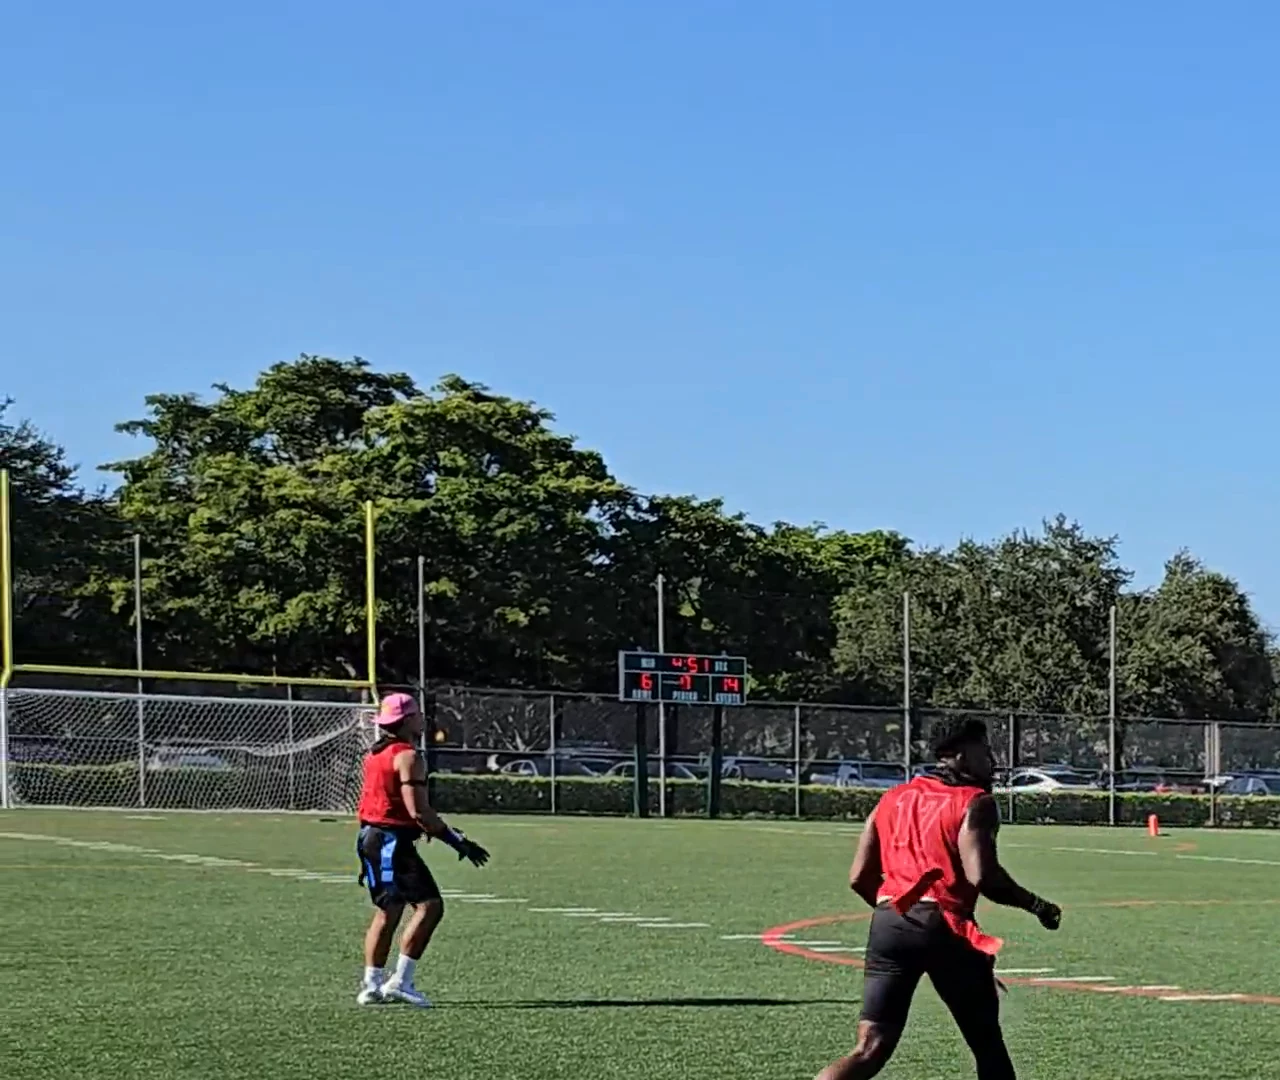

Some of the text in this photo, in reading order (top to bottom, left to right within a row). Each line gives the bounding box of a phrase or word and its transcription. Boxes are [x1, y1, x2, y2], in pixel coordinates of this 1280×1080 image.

[642, 673, 653, 689] 6
[723, 678, 739, 692] 14
[893, 788, 953, 851] 17
